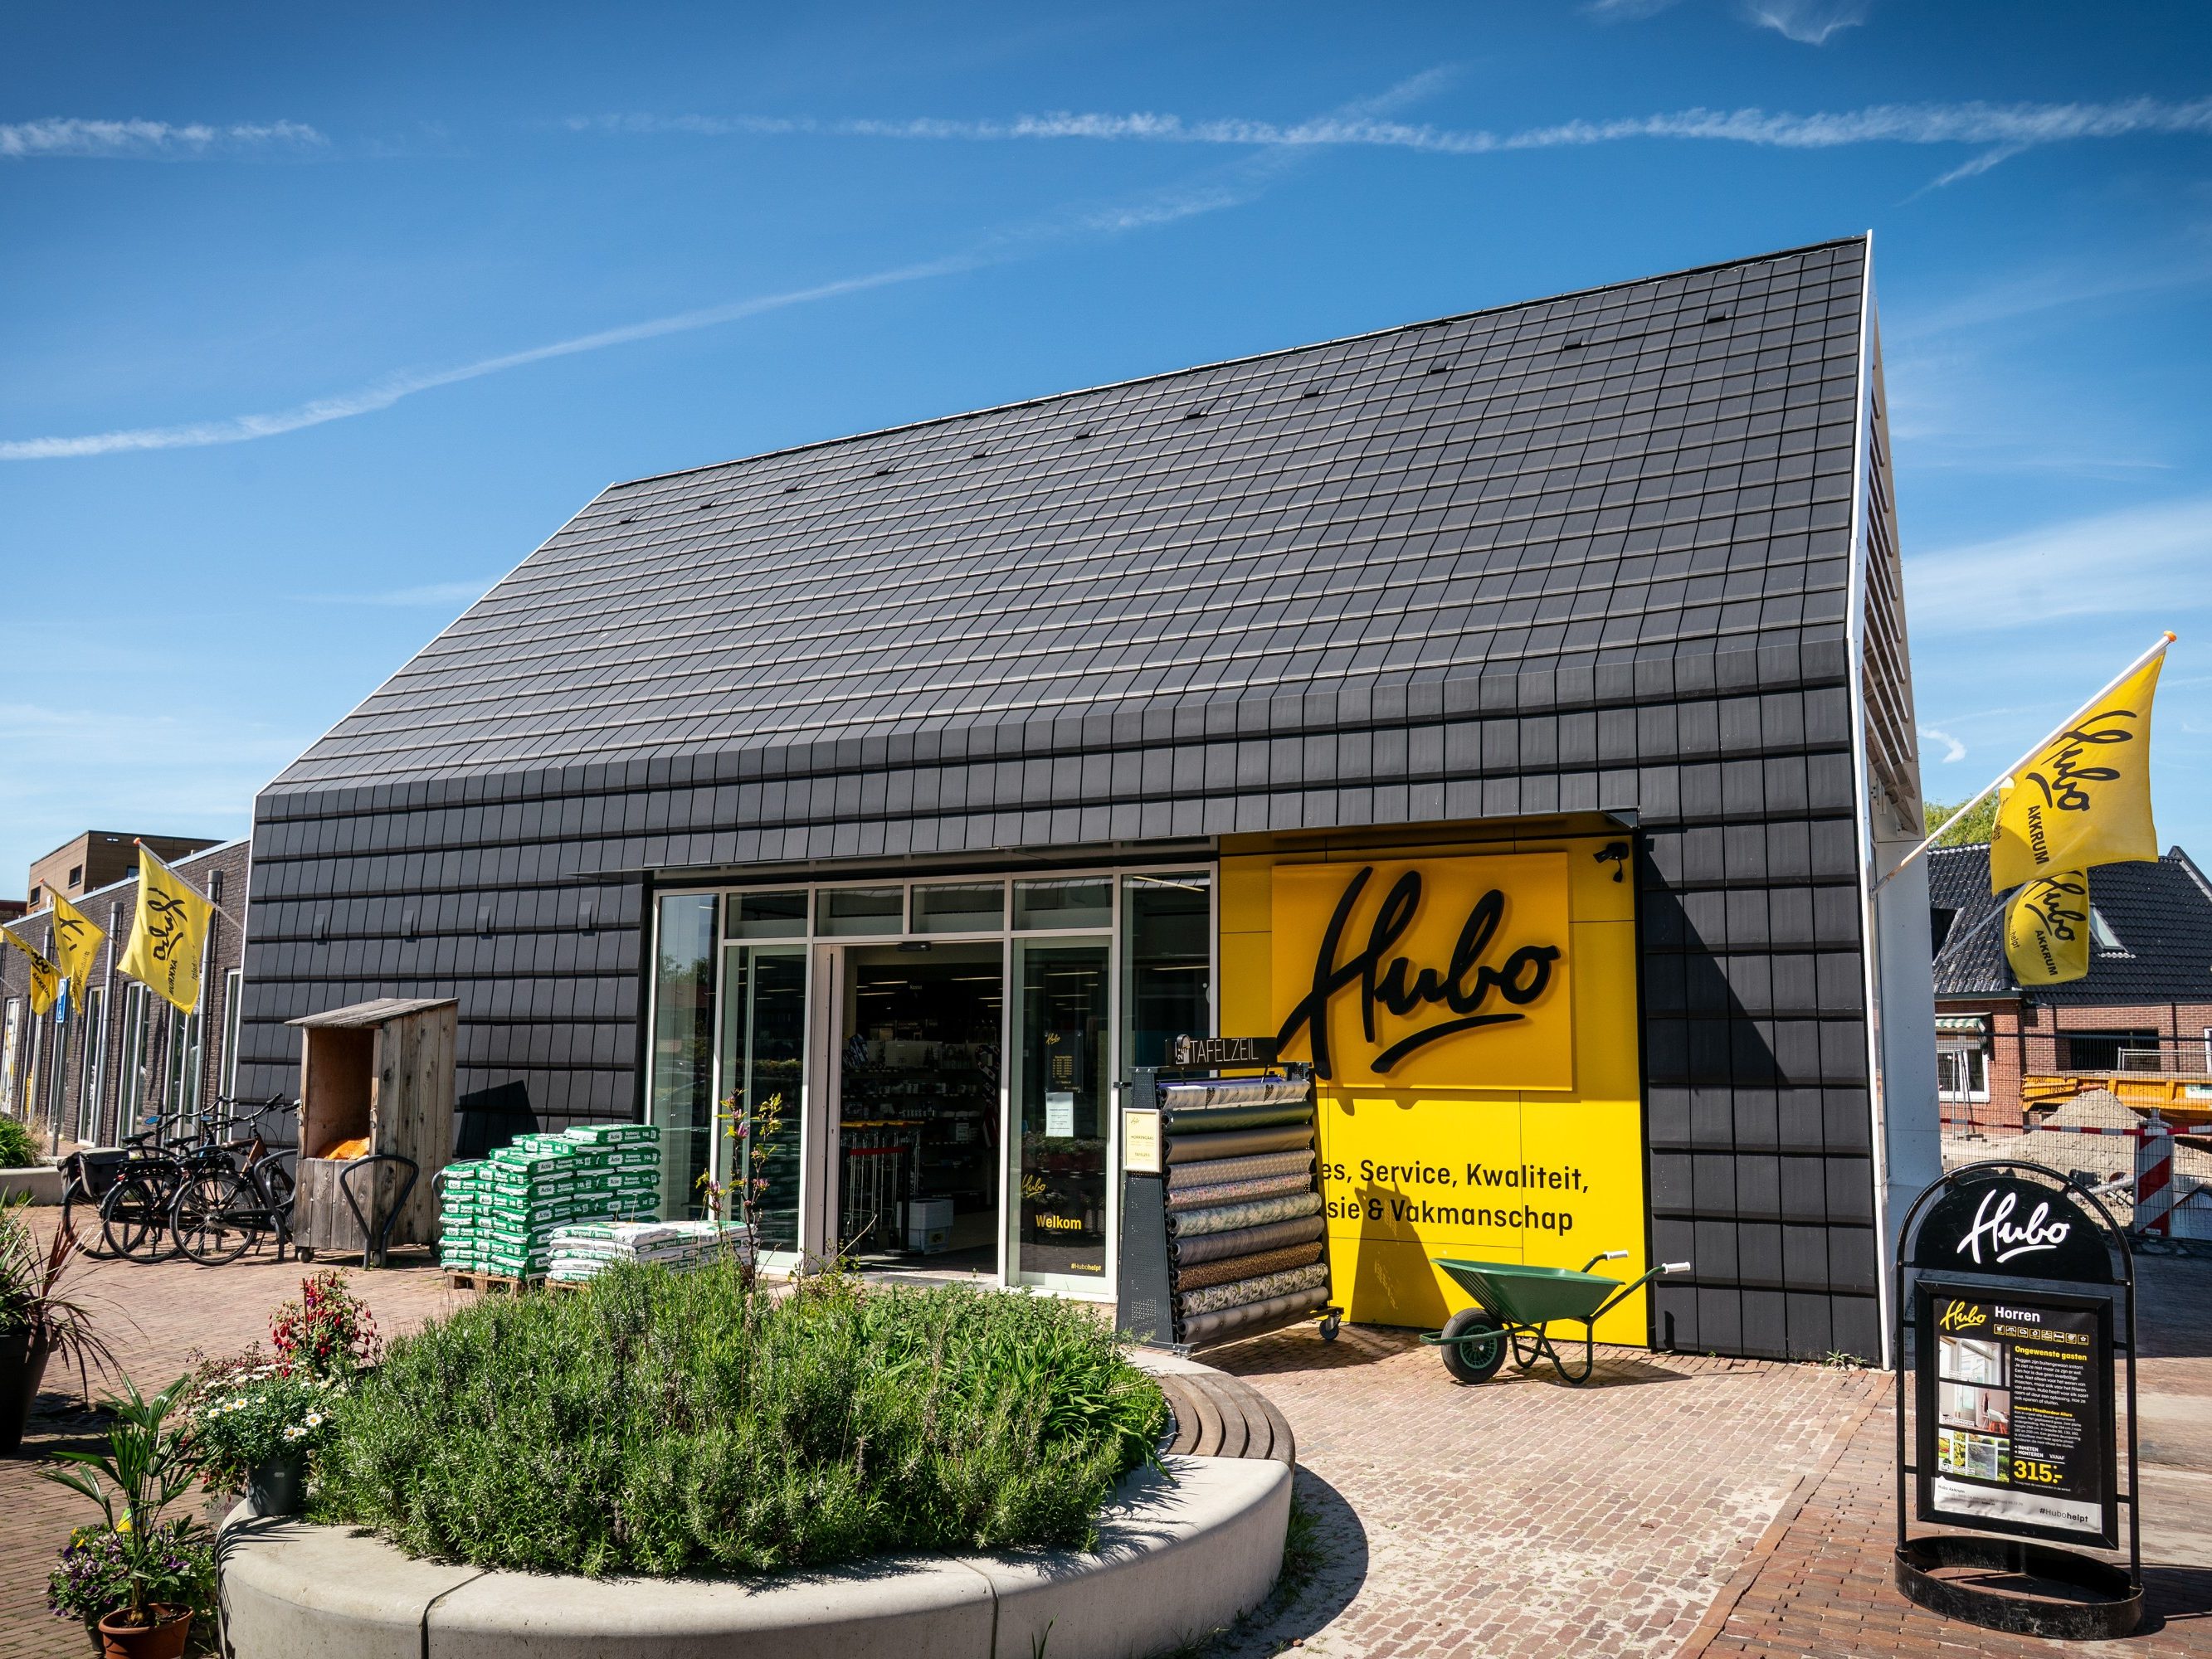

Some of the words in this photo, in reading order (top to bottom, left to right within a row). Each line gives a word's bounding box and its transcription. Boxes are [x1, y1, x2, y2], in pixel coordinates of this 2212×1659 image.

[2025, 710, 2137, 811] Hubo
[2028, 805, 2050, 865] AKKRUM
[2023, 871, 2086, 941] Hubo
[2035, 930, 2058, 975] AKKRUM
[1276, 866, 1562, 1080] Hubo
[1190, 1039, 1259, 1063] TAFELZEIL
[1021, 1174, 1046, 1198] Hubo
[1323, 1163, 1352, 1184] es,
[1361, 1160, 1458, 1188] Service,
[1467, 1163, 1589, 1193] Kwaliteit,
[1035, 1214, 1082, 1230] Welkom
[1327, 1196, 1360, 1219] sie
[1367, 1198, 1384, 1221] &
[1391, 1199, 1573, 1236] Vakmanschap
[1956, 1189, 2071, 1264] Hubo
[1070, 1263, 1101, 1272] #Hubohelpt
[1939, 1299, 1987, 1331] Hubo
[1995, 1306, 2041, 1323] Horren
[2015, 1345, 2060, 1358] Ongewenste
[2039, 1507, 2089, 1523] #Hubohelpt
